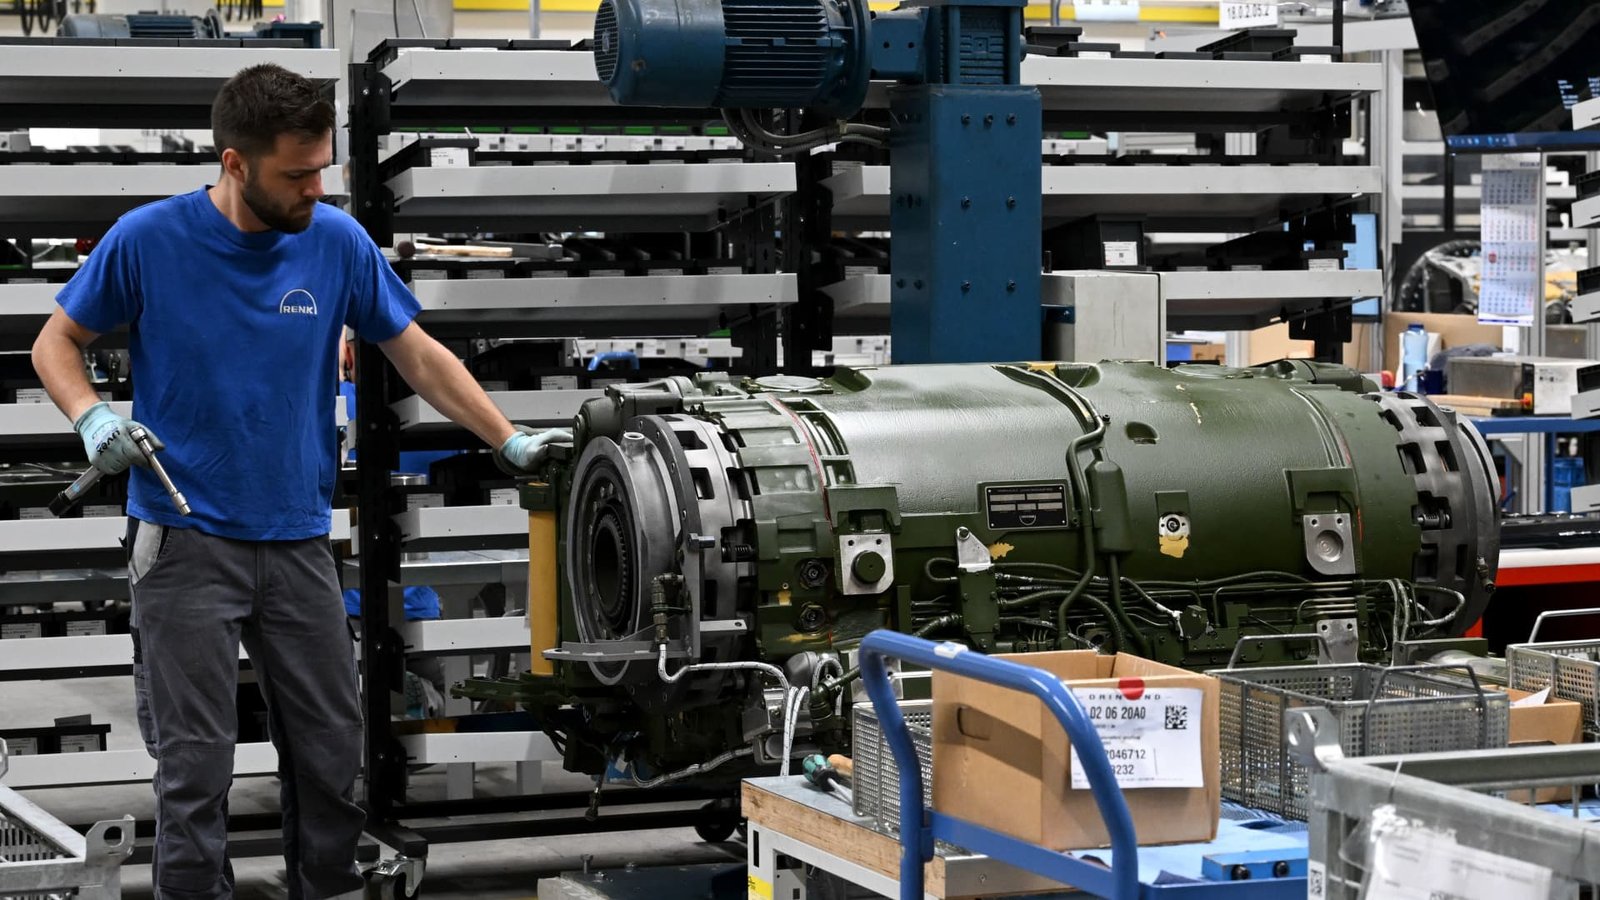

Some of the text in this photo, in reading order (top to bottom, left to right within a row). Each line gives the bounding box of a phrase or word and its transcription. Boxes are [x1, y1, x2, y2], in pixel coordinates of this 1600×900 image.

[283, 305, 314, 314] RENK
[97, 429, 120, 455] uvex
[1090, 706, 1146, 720] 02 06 20A0
